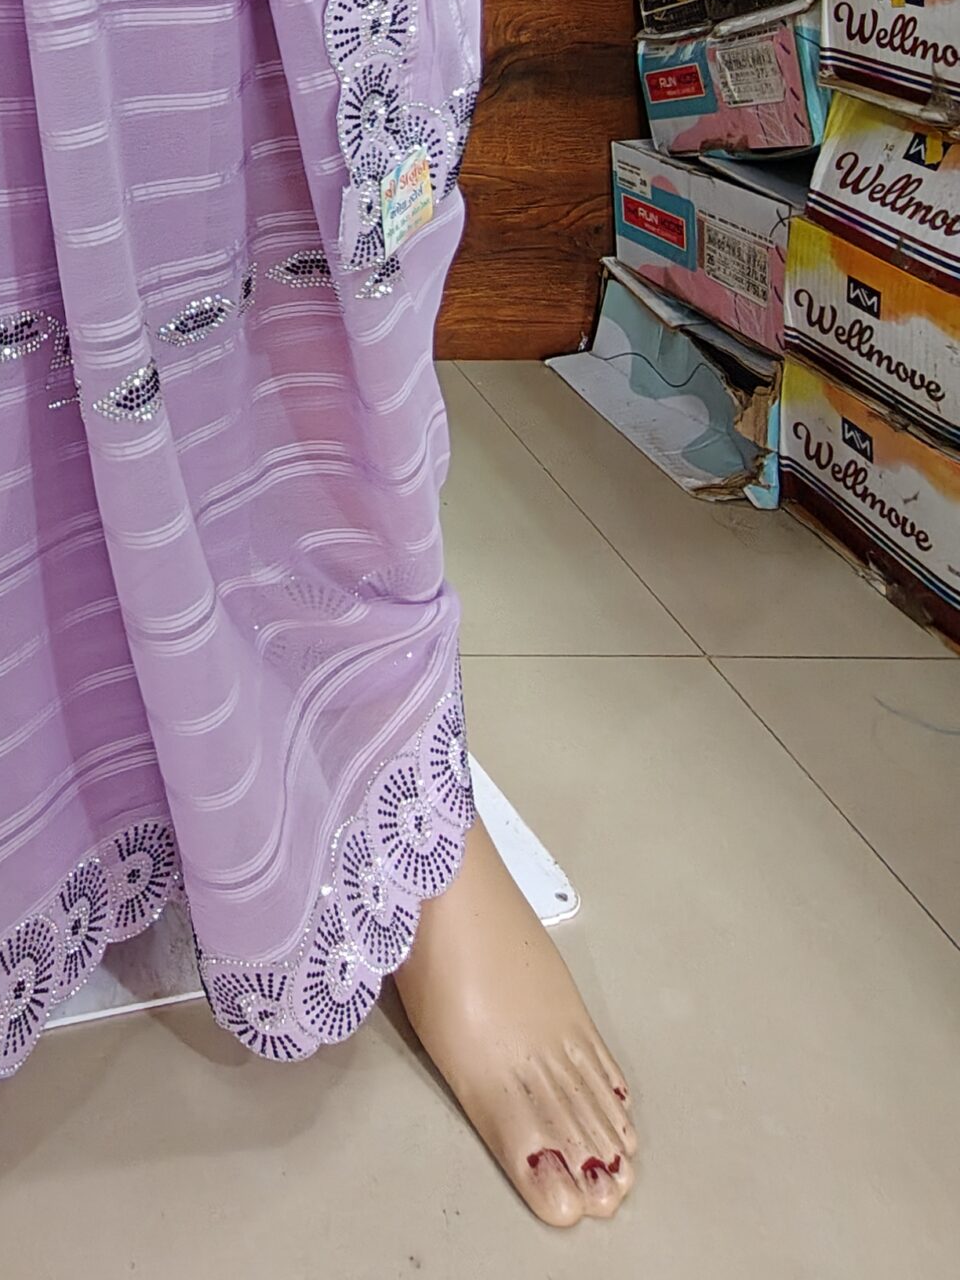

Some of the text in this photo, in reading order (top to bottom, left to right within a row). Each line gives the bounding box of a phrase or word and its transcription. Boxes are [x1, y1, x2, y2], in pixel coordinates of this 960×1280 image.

[658, 77, 677, 89] RUN
[637, 207, 659, 225] RUN
[794, 288, 945, 402] Wellmove
[792, 422, 933, 552] Wellmove
